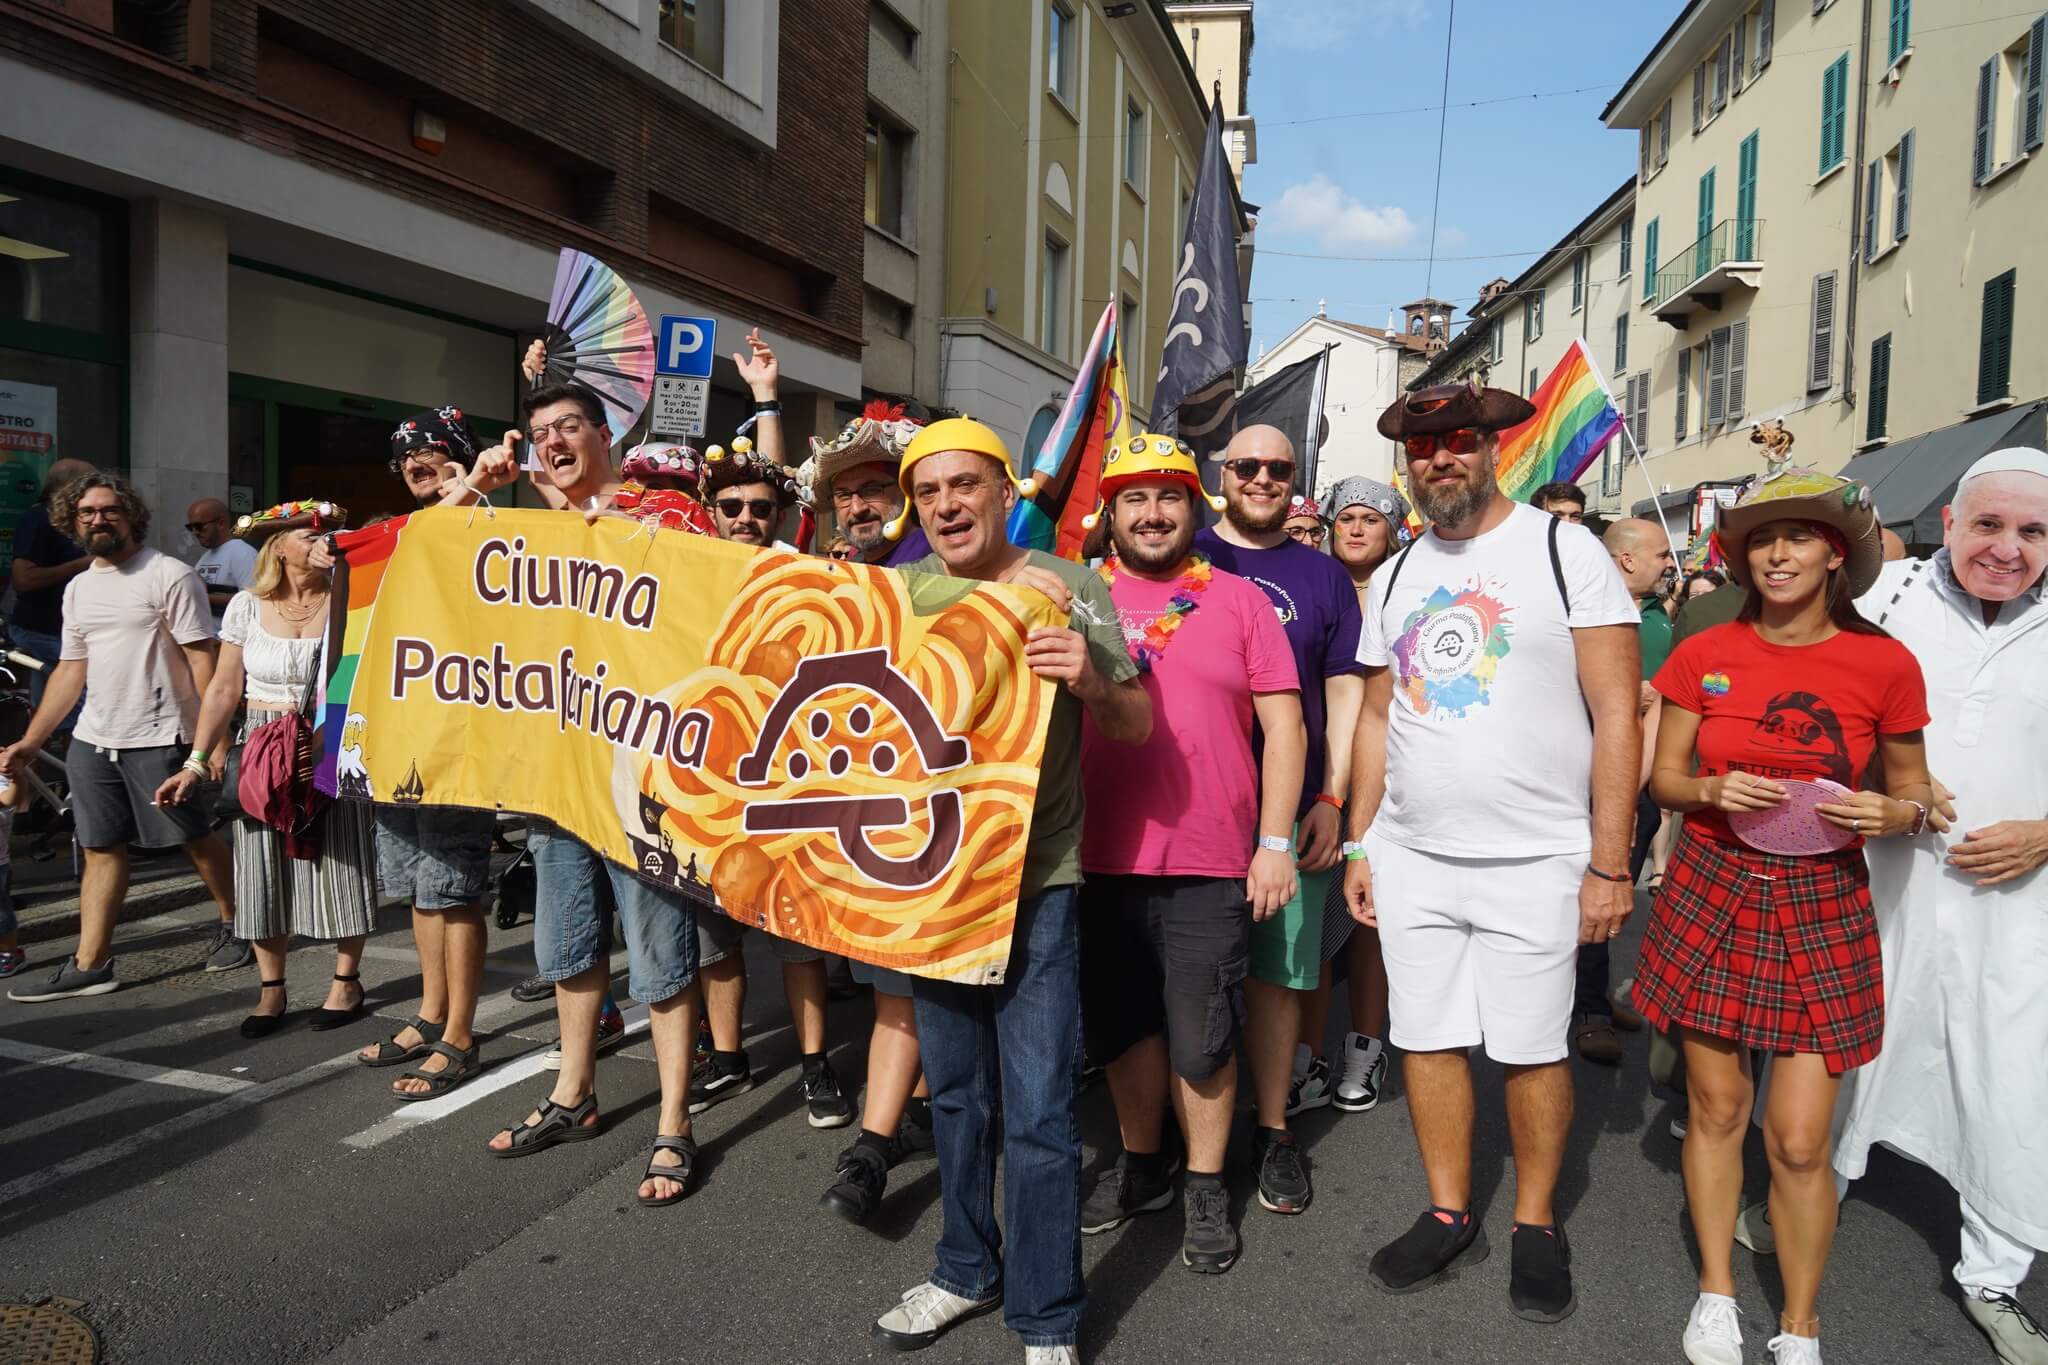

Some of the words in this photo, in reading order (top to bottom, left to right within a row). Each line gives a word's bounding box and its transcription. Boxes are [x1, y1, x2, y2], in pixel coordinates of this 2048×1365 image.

[668, 322, 703, 368] P
[475, 537, 659, 629] Ciurma
[1423, 616, 1448, 637] Ciurma
[1449, 612, 1479, 643] Pastafariana
[392, 638, 712, 769] Pastafariana
[1727, 761, 1792, 779] BETTER
